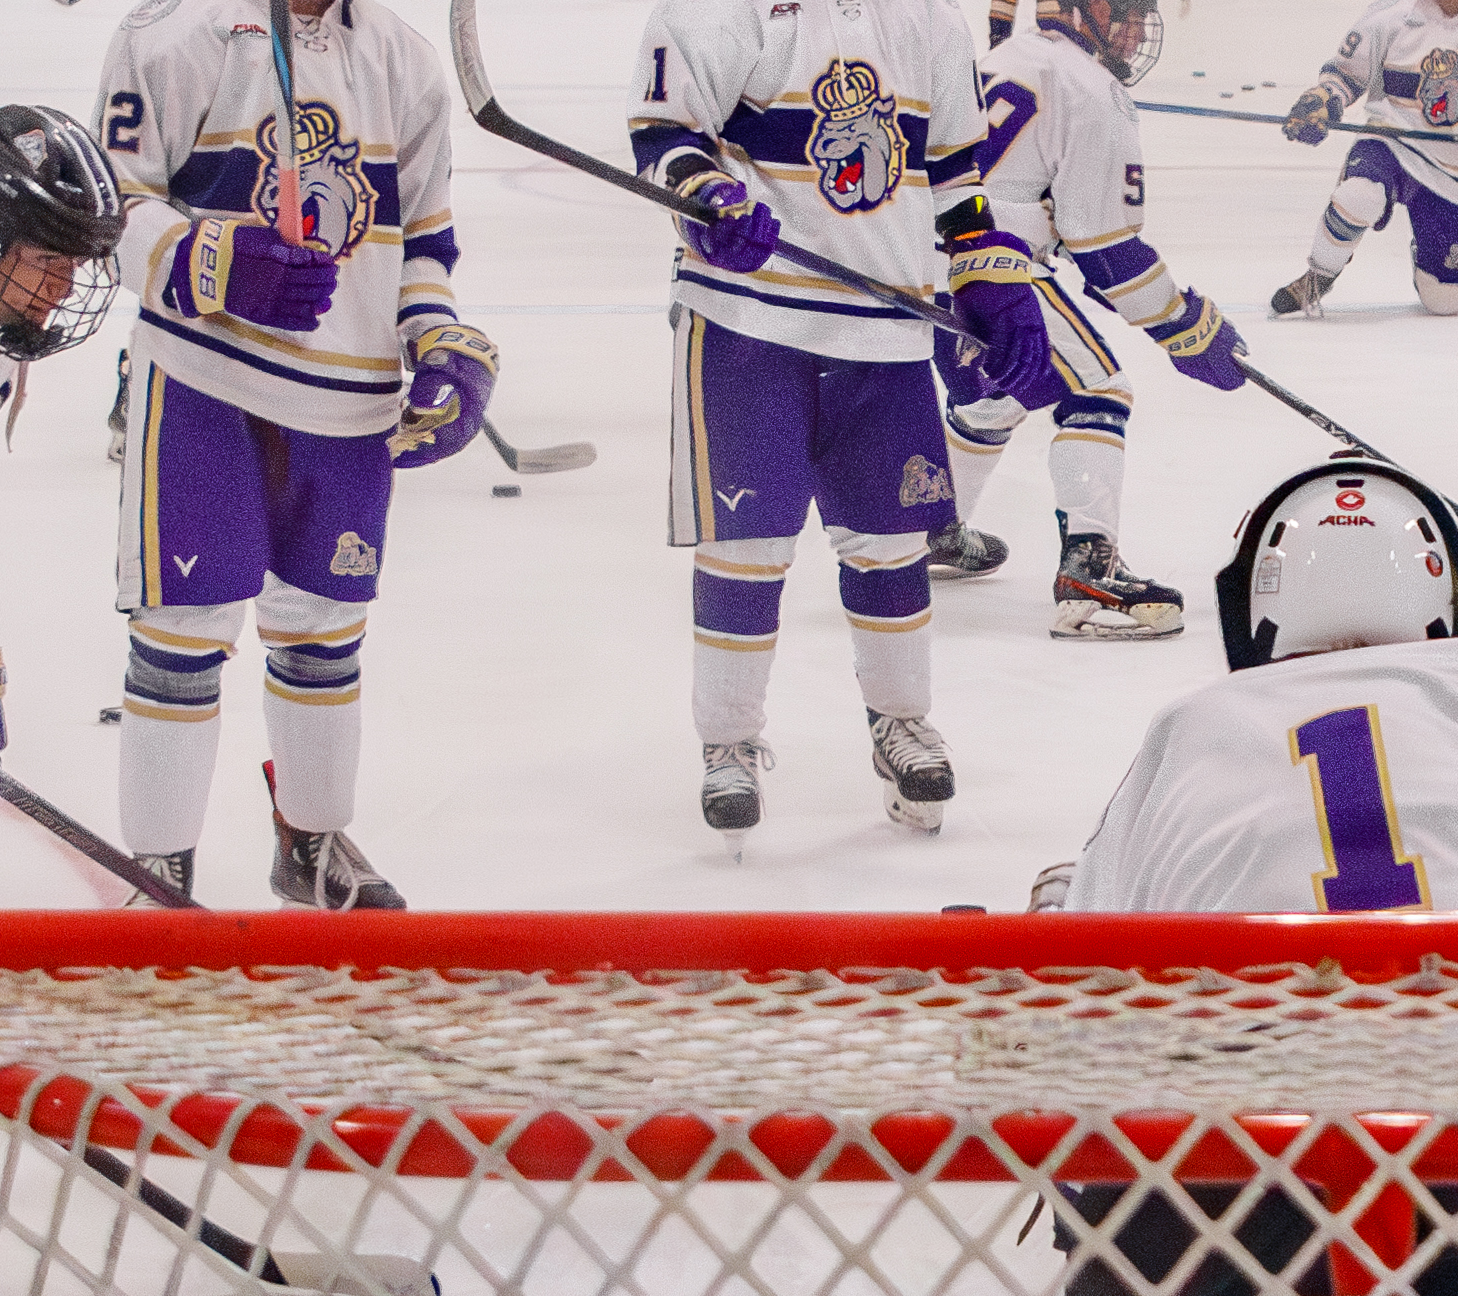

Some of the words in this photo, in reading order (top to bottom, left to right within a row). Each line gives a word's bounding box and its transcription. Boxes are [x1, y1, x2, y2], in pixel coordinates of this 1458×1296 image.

[107, 91, 144, 154] 2
[1318, 514, 1376, 528] ACHA
[1287, 703, 1433, 912] 1
